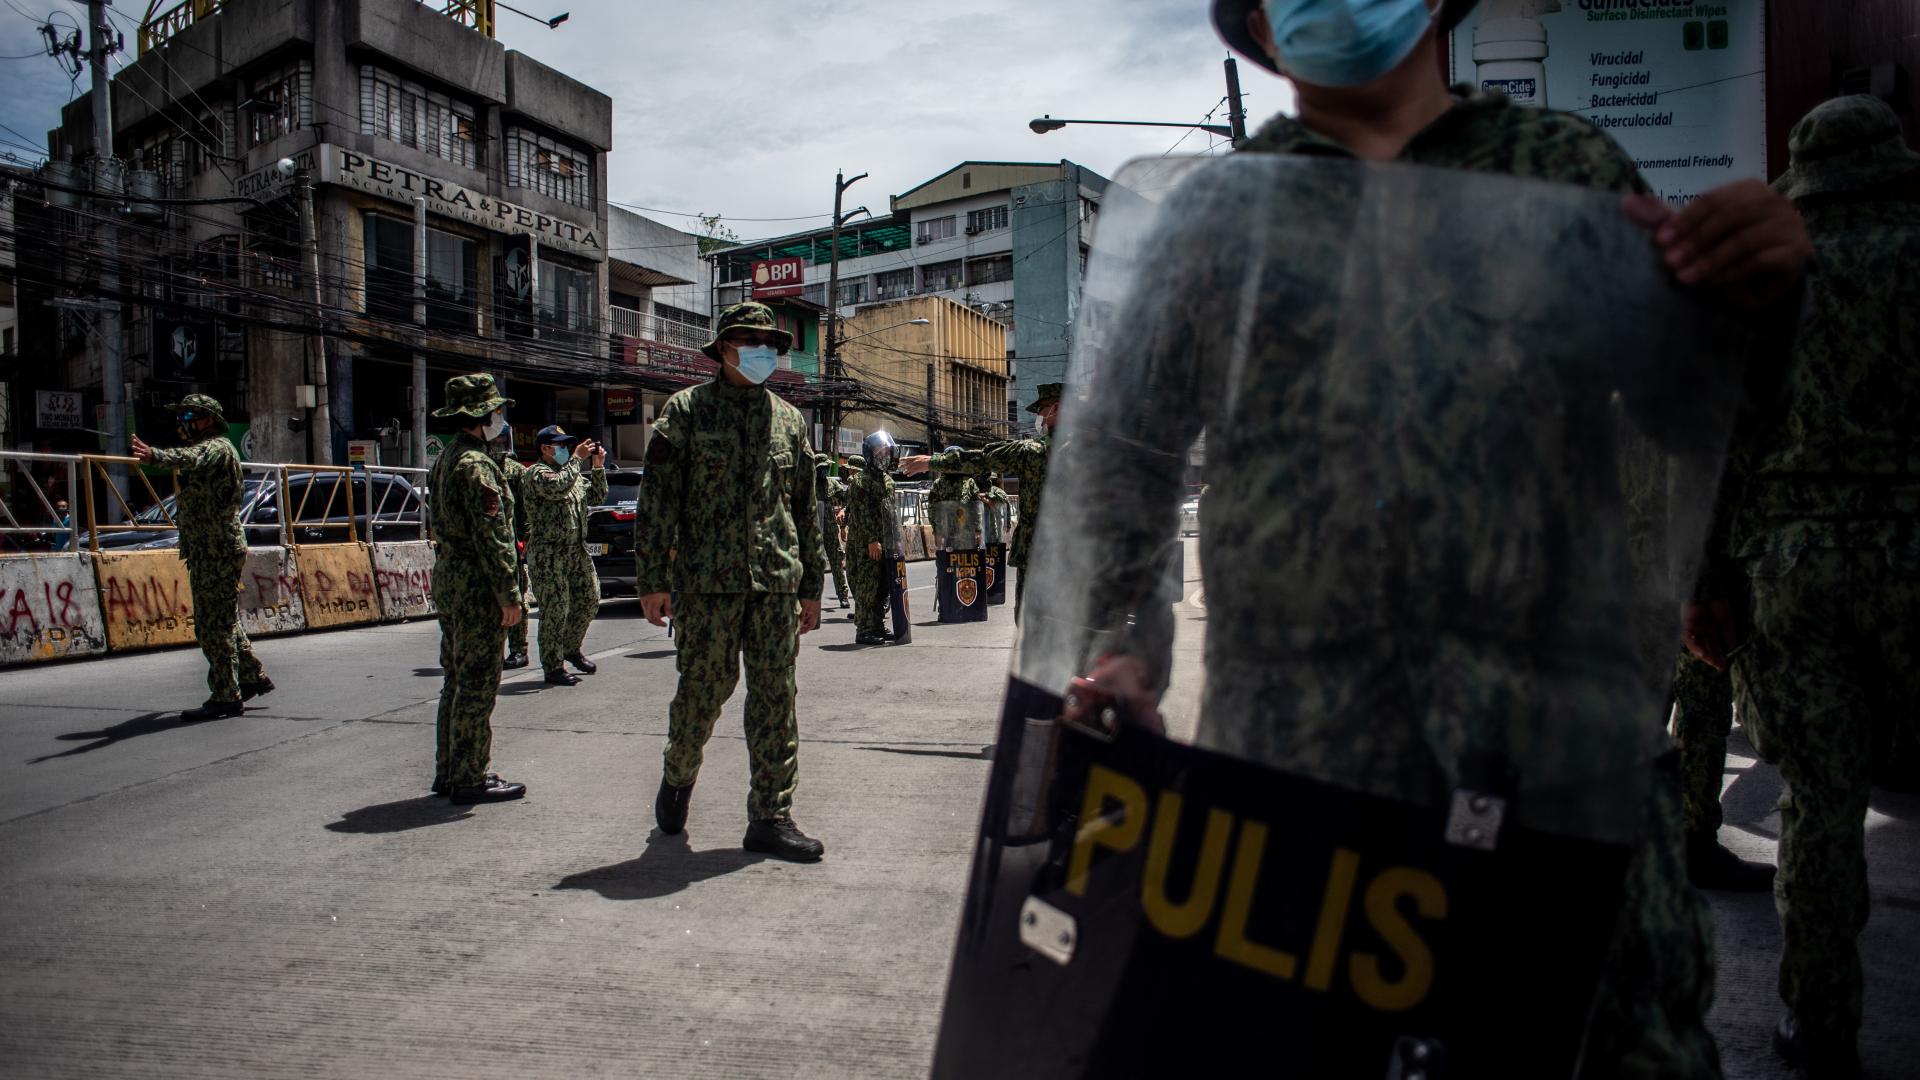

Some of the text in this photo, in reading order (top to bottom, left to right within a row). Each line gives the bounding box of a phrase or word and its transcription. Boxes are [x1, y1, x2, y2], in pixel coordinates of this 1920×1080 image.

[1587, 5, 1727, 21] Surface Disinfectant Wipes
[1591, 51, 1643, 66] Virucidal
[1592, 71, 1650, 89] Fungicidal
[1591, 92, 1658, 108] Bactericidal
[1591, 112, 1672, 128] Tuberculocidal
[1631, 154, 1734, 170] vironmental Friendly
[238, 169, 271, 197] PETRA
[340, 150, 476, 211] PETRA
[479, 199, 490, 212] &
[494, 201, 601, 250] PEPITA
[340, 174, 453, 214] ENCARNAION
[462, 211, 505, 230] GROUP
[541, 235, 571, 249] ALON
[770, 262, 798, 281] BPI
[949, 552, 980, 567] PULIS
[0, 588, 37, 632] A
[45, 581, 83, 627] 18
[243, 603, 291, 625] MDA
[320, 599, 370, 615] MMDA
[1065, 761, 1451, 1014] PULIS
